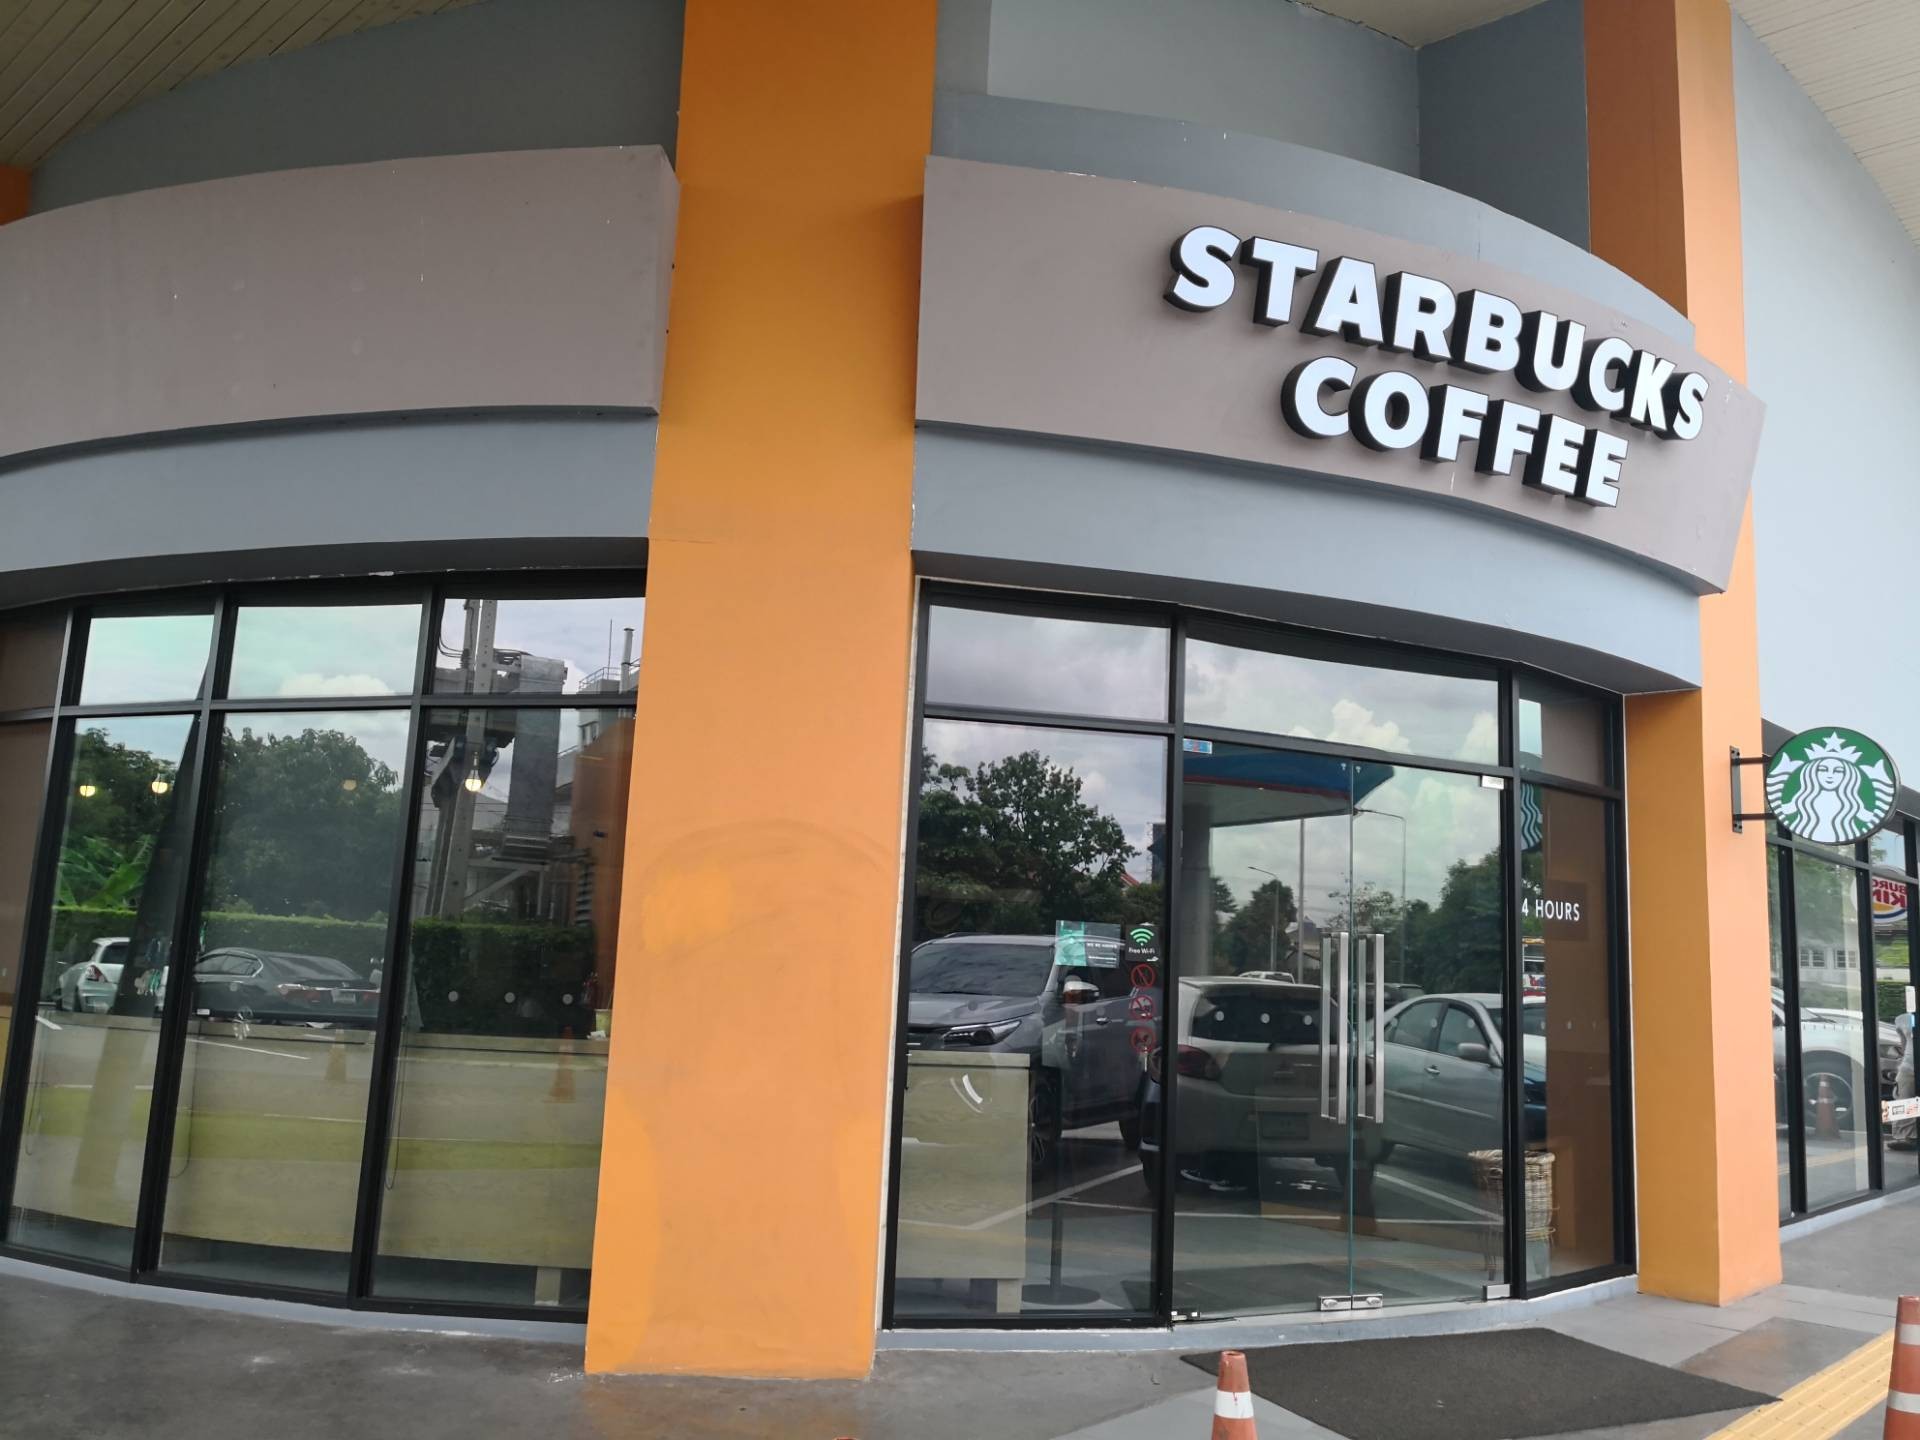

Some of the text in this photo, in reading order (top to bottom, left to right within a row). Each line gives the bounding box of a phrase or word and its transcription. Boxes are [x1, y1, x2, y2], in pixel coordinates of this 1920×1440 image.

[1166, 226, 1708, 440] STARBUCKS
[1283, 355, 1629, 508] COFFEE
[1521, 897, 1580, 922] 4 HOURS
